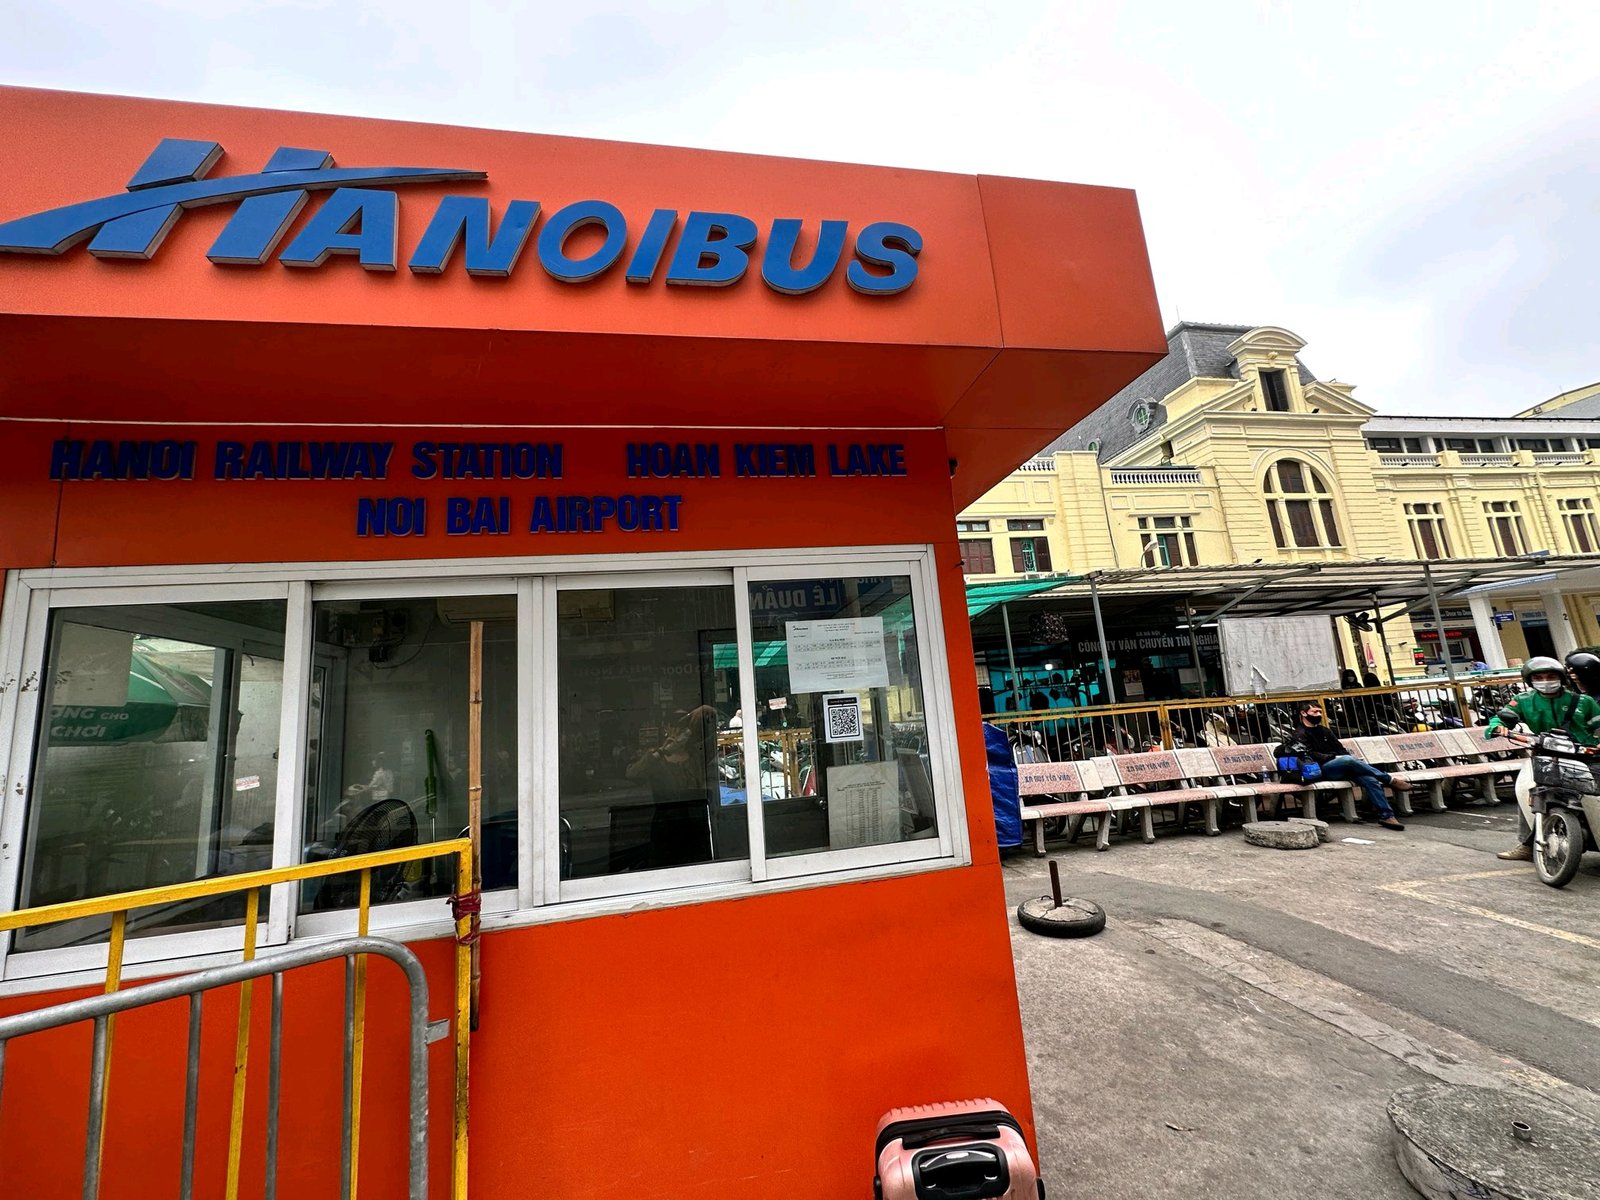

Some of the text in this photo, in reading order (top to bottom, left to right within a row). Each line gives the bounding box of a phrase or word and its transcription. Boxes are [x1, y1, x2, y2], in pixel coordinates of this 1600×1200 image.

[50, 440, 907, 482] HANOI RAILWAY STATION HOAN KIEM LAKE
[357, 494, 683, 539] NOI BAI AIRPORT
[101, 712, 129, 721] CHO
